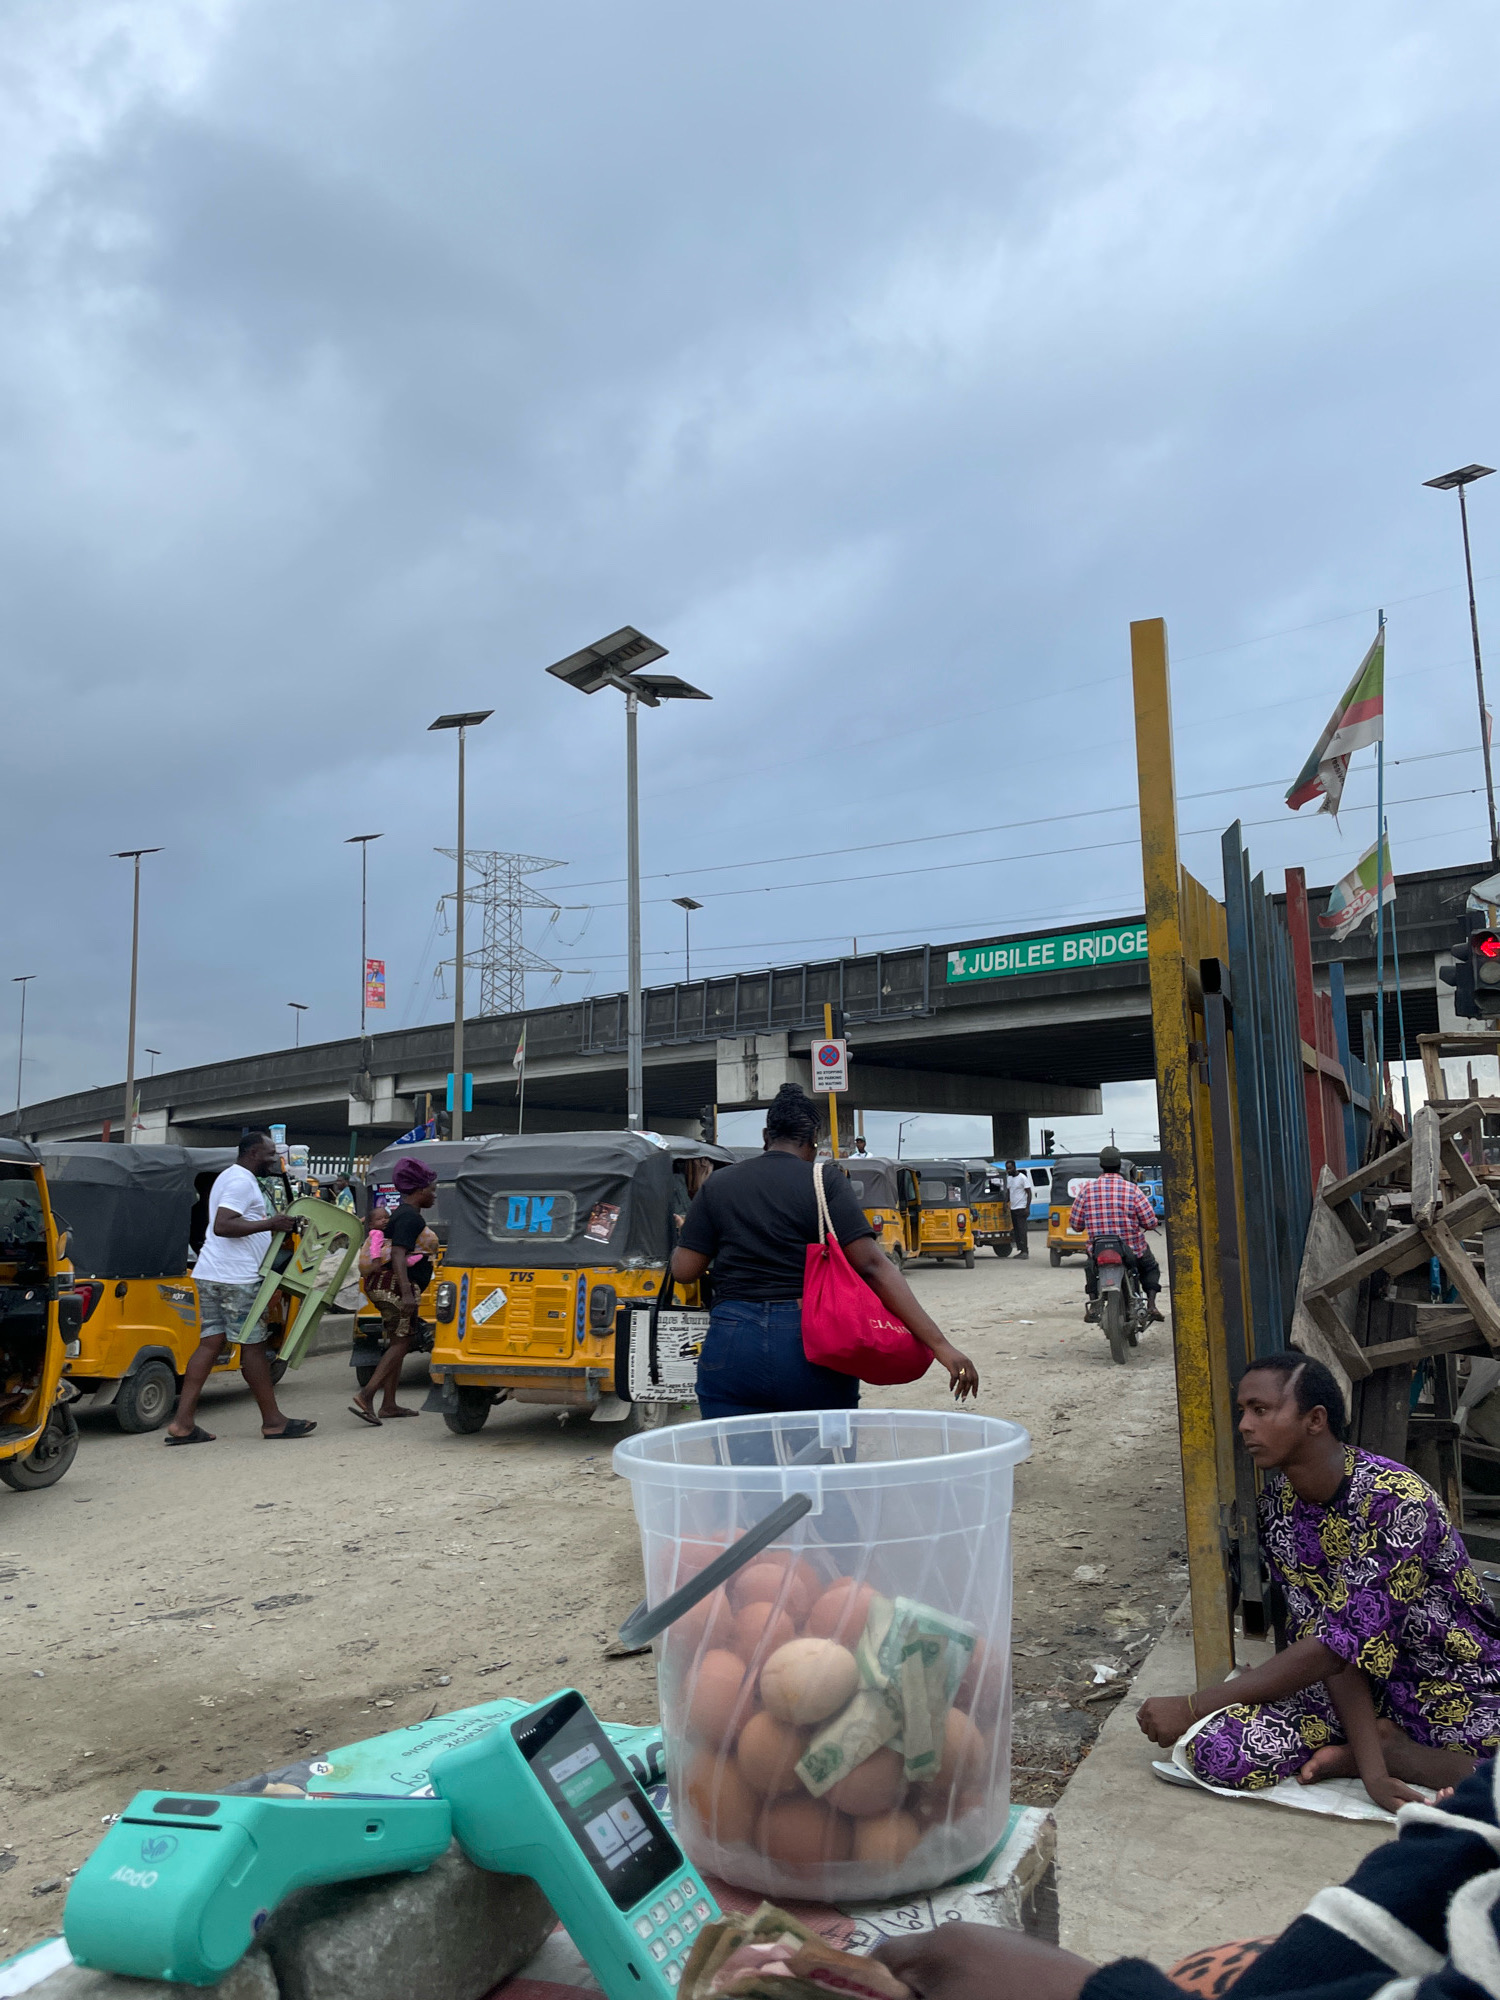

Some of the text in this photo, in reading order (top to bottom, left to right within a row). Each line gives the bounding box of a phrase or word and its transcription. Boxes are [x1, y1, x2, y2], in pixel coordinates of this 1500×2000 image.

[969, 930, 1148, 974] JUBILEE BRIDGE
[509, 1271, 535, 1282] TVS
[401, 1731, 458, 1757] Reliable
